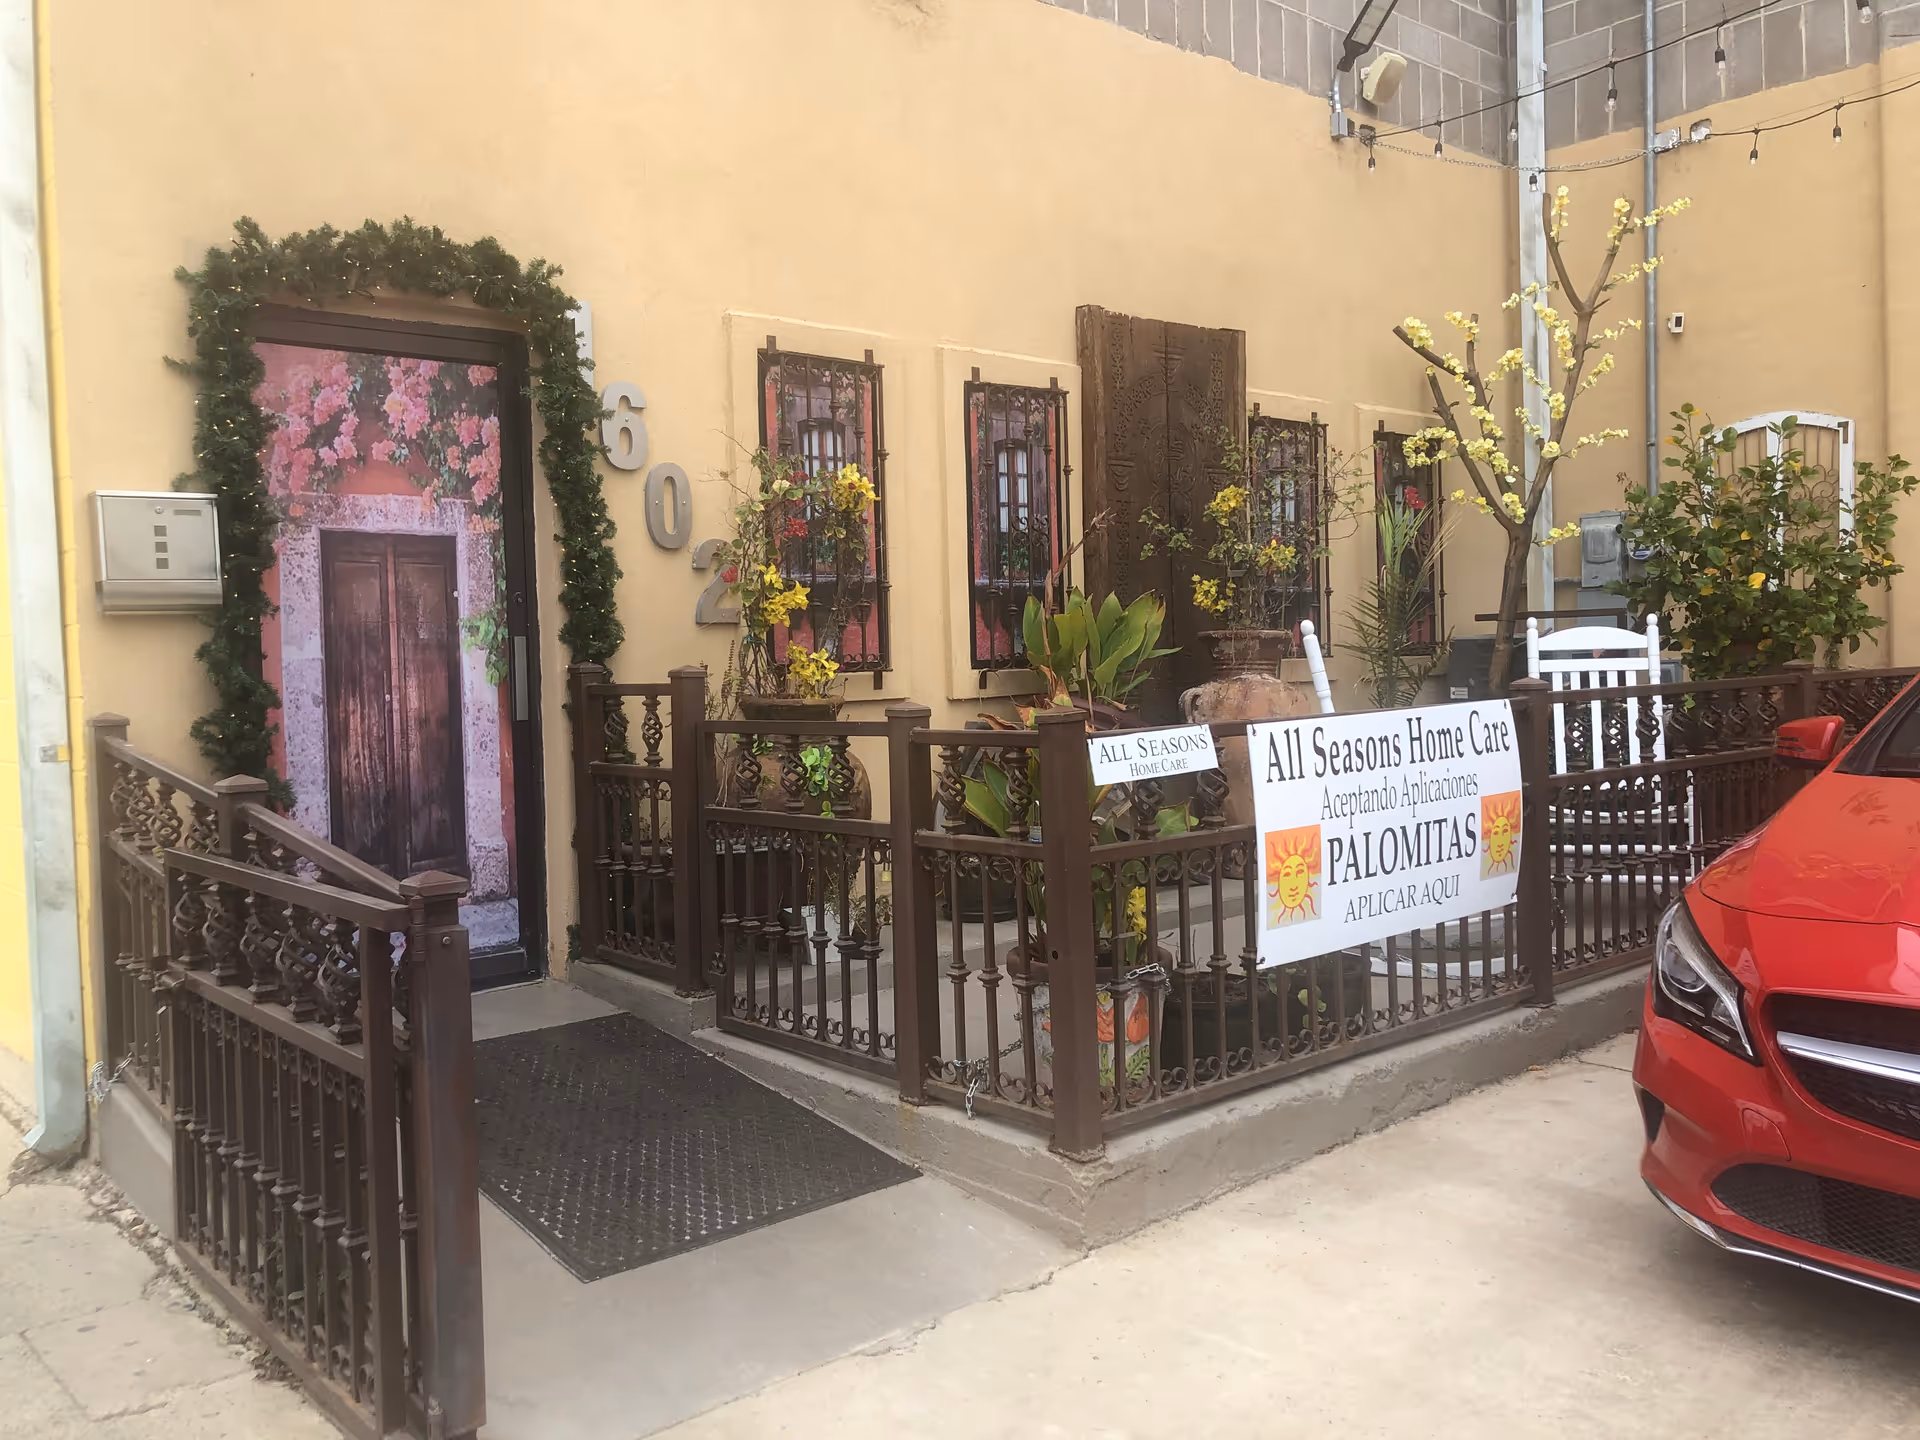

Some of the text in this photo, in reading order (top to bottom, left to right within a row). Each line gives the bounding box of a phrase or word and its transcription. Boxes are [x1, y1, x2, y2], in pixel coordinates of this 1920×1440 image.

[1100, 734, 1208, 764] ALL SEASONS
[1266, 711, 1511, 783] All Seasons Home Care
[1321, 768, 1479, 828] Aceptando Aplicaciones
[1327, 812, 1477, 885] PALOMITAS
[1345, 873, 1461, 923] APLICAR AQUI
